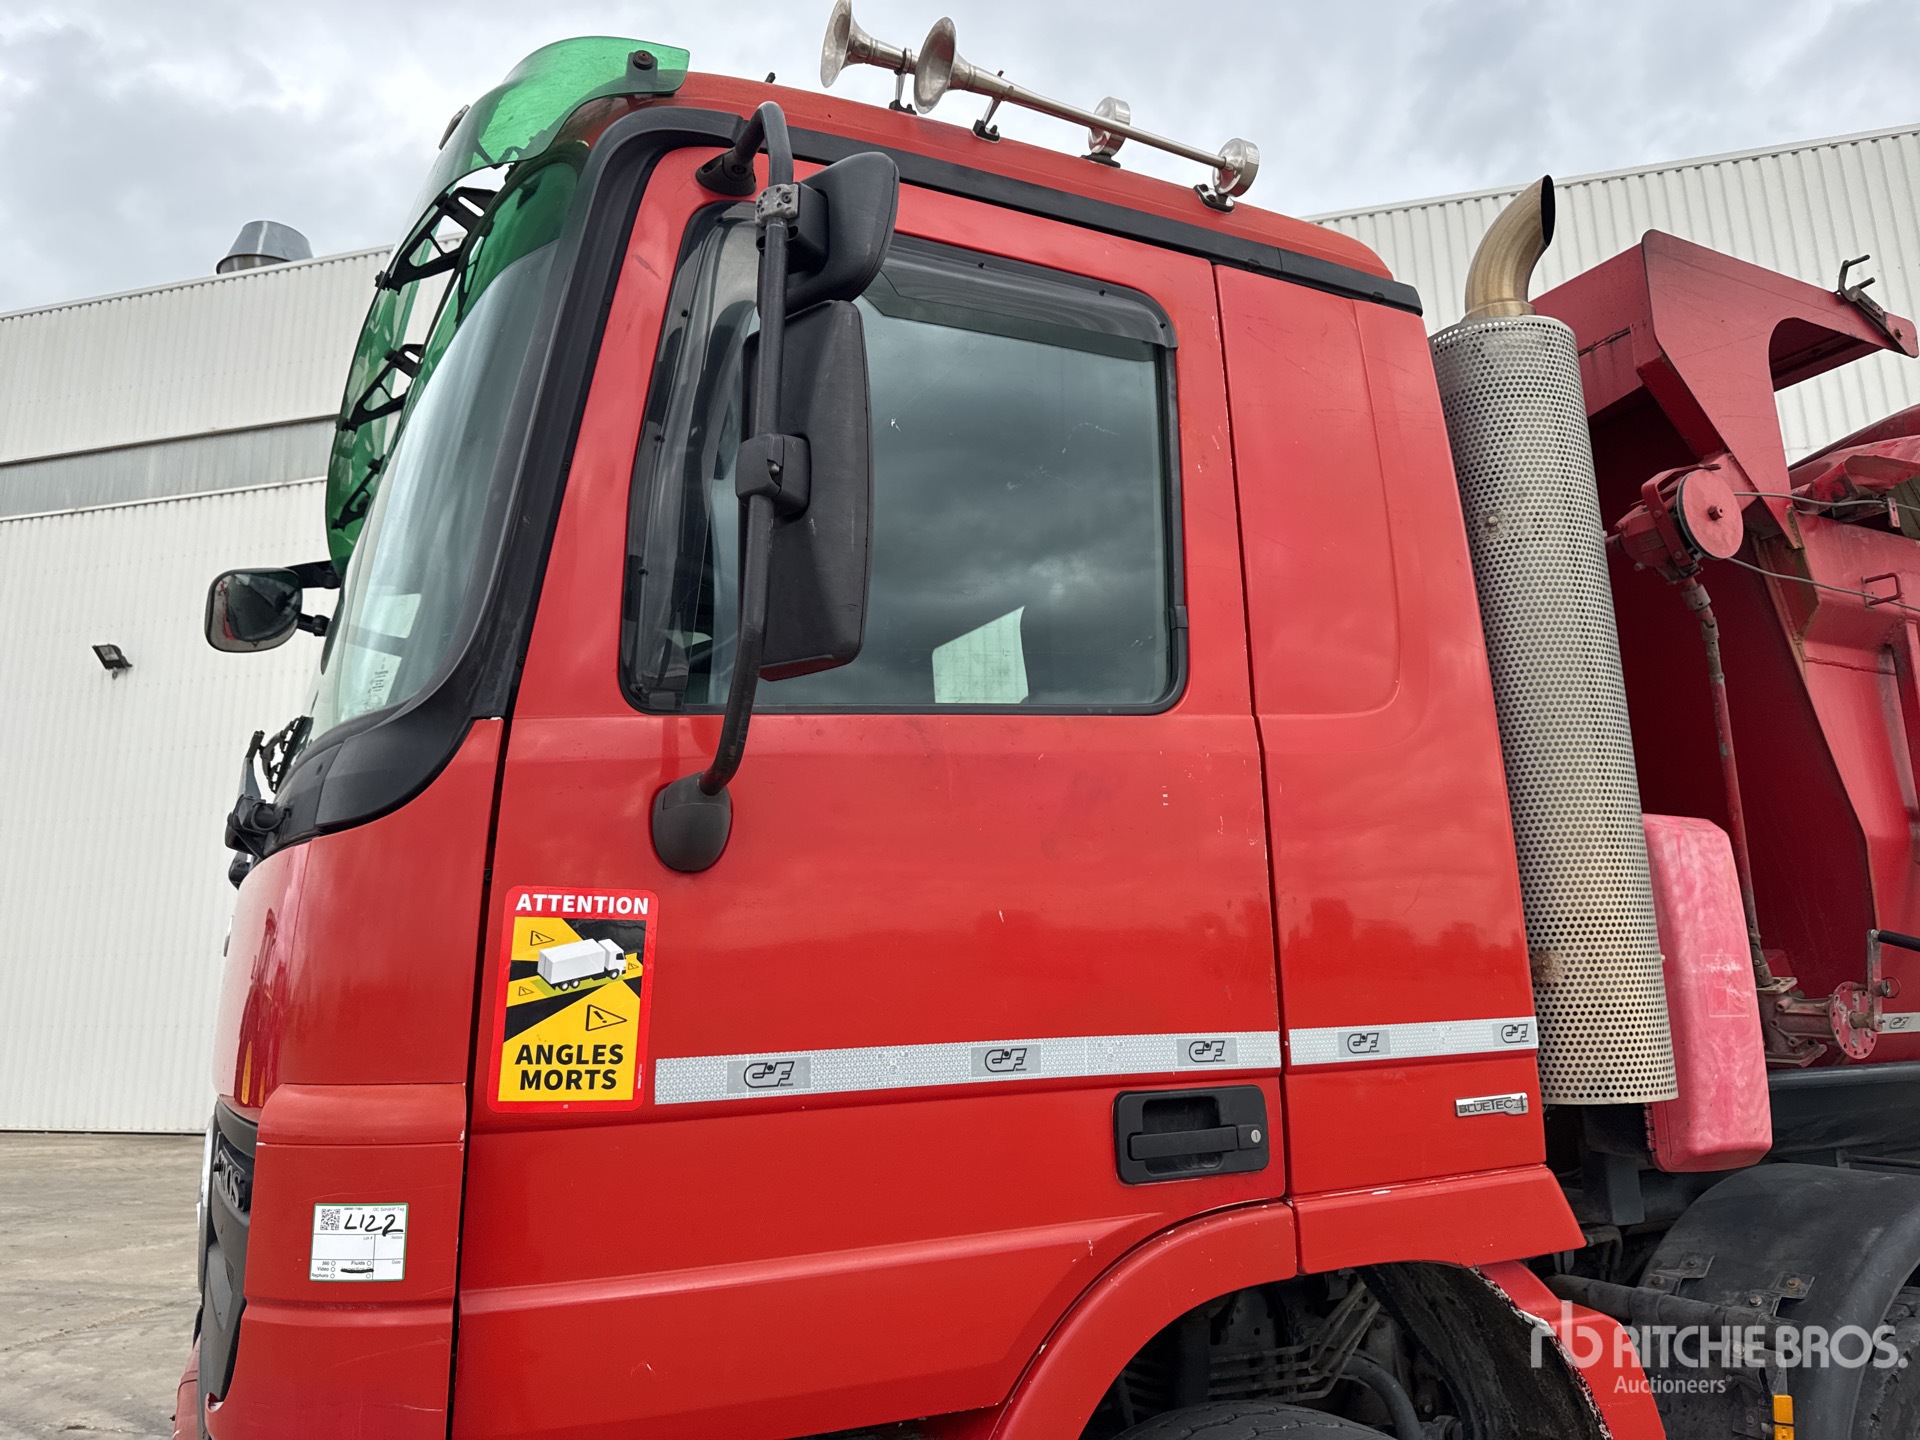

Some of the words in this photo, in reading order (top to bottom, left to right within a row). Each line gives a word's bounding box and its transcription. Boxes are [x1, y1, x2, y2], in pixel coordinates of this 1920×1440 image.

[516, 893, 649, 915] ATTENTION
[515, 1044, 624, 1065] ANGLES
[519, 1069, 617, 1090] MORTS
[344, 1213, 404, 1237] L122
